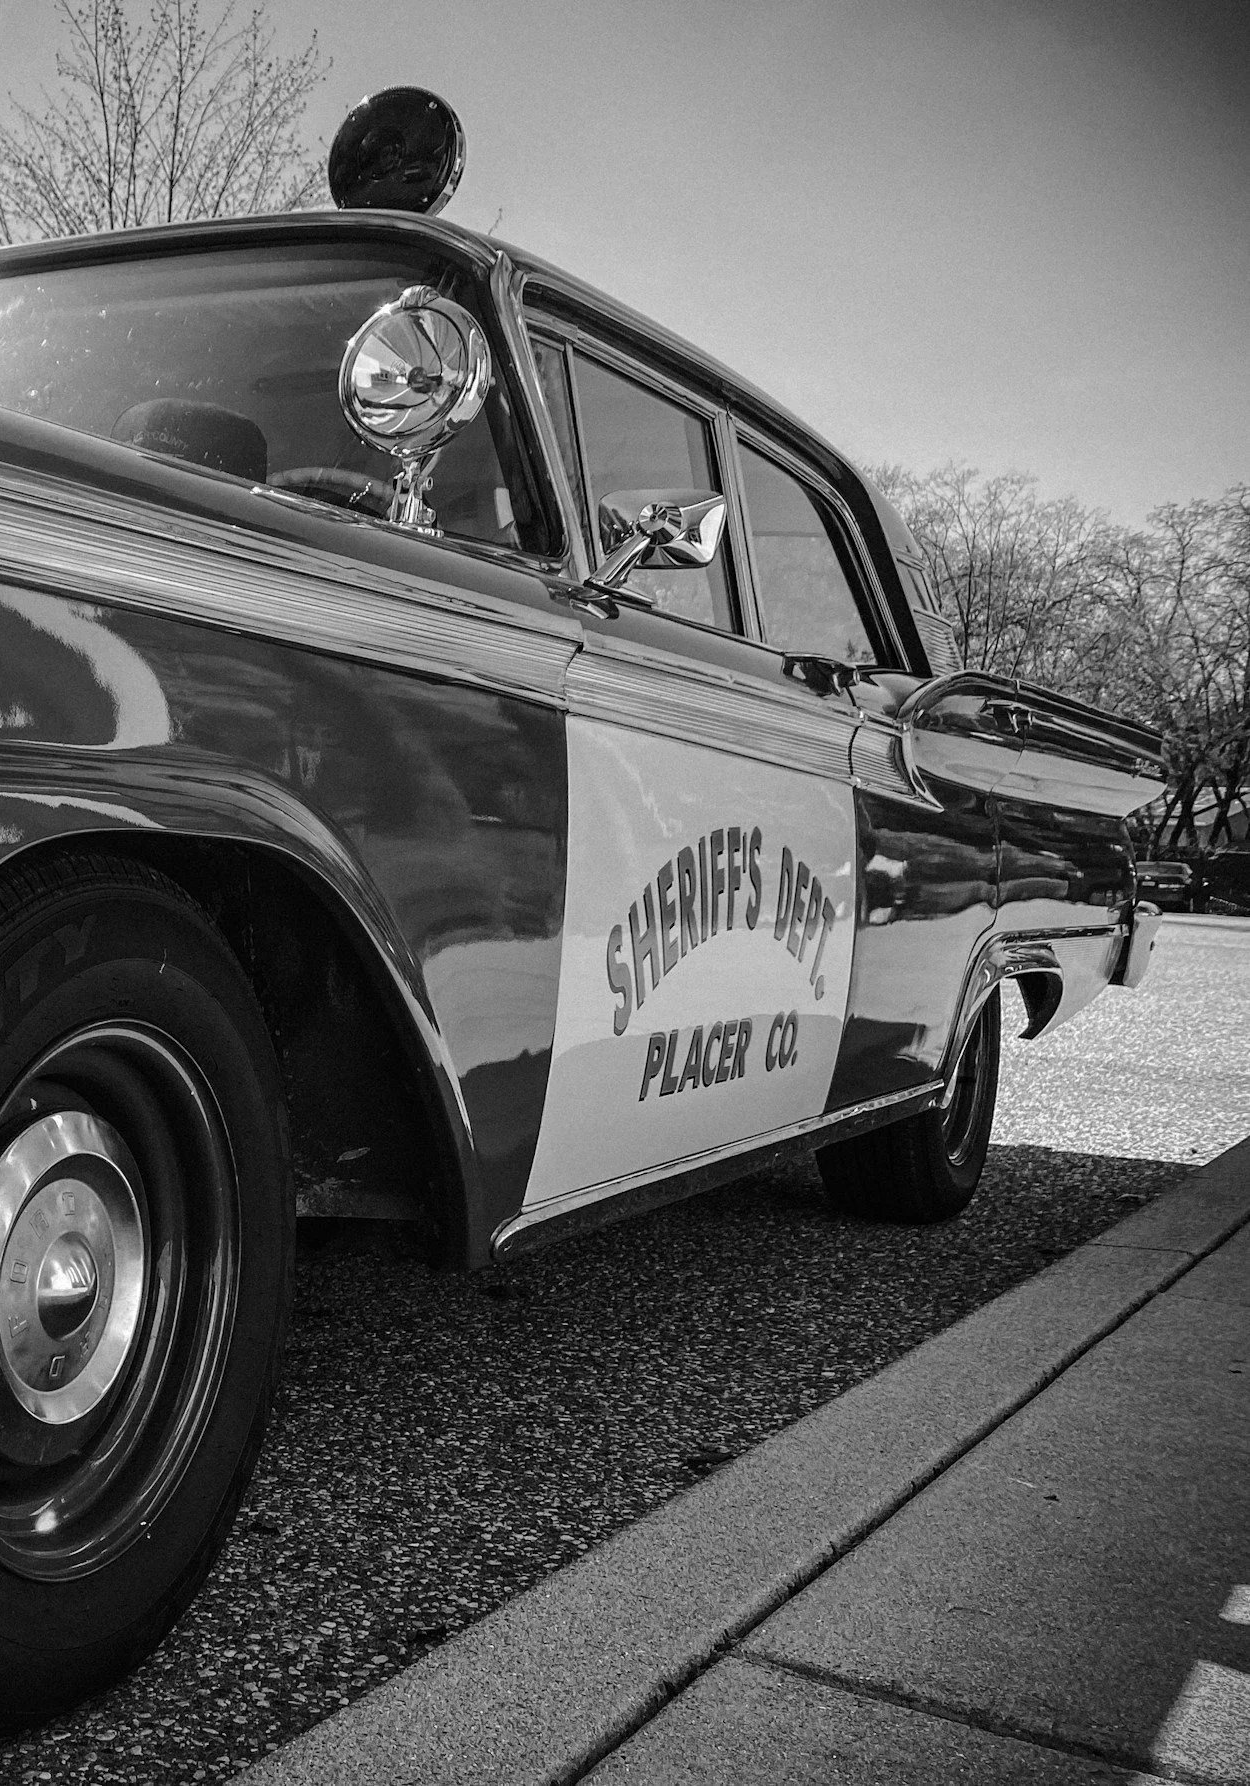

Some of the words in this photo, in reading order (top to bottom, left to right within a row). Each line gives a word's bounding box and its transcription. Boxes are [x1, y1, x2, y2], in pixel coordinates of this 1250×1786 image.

[606, 826, 762, 1036] SHERIFF'S
[773, 845, 836, 1001] DEPT.
[638, 1018, 752, 1102] PLACER
[765, 1009, 798, 1072] CO.
